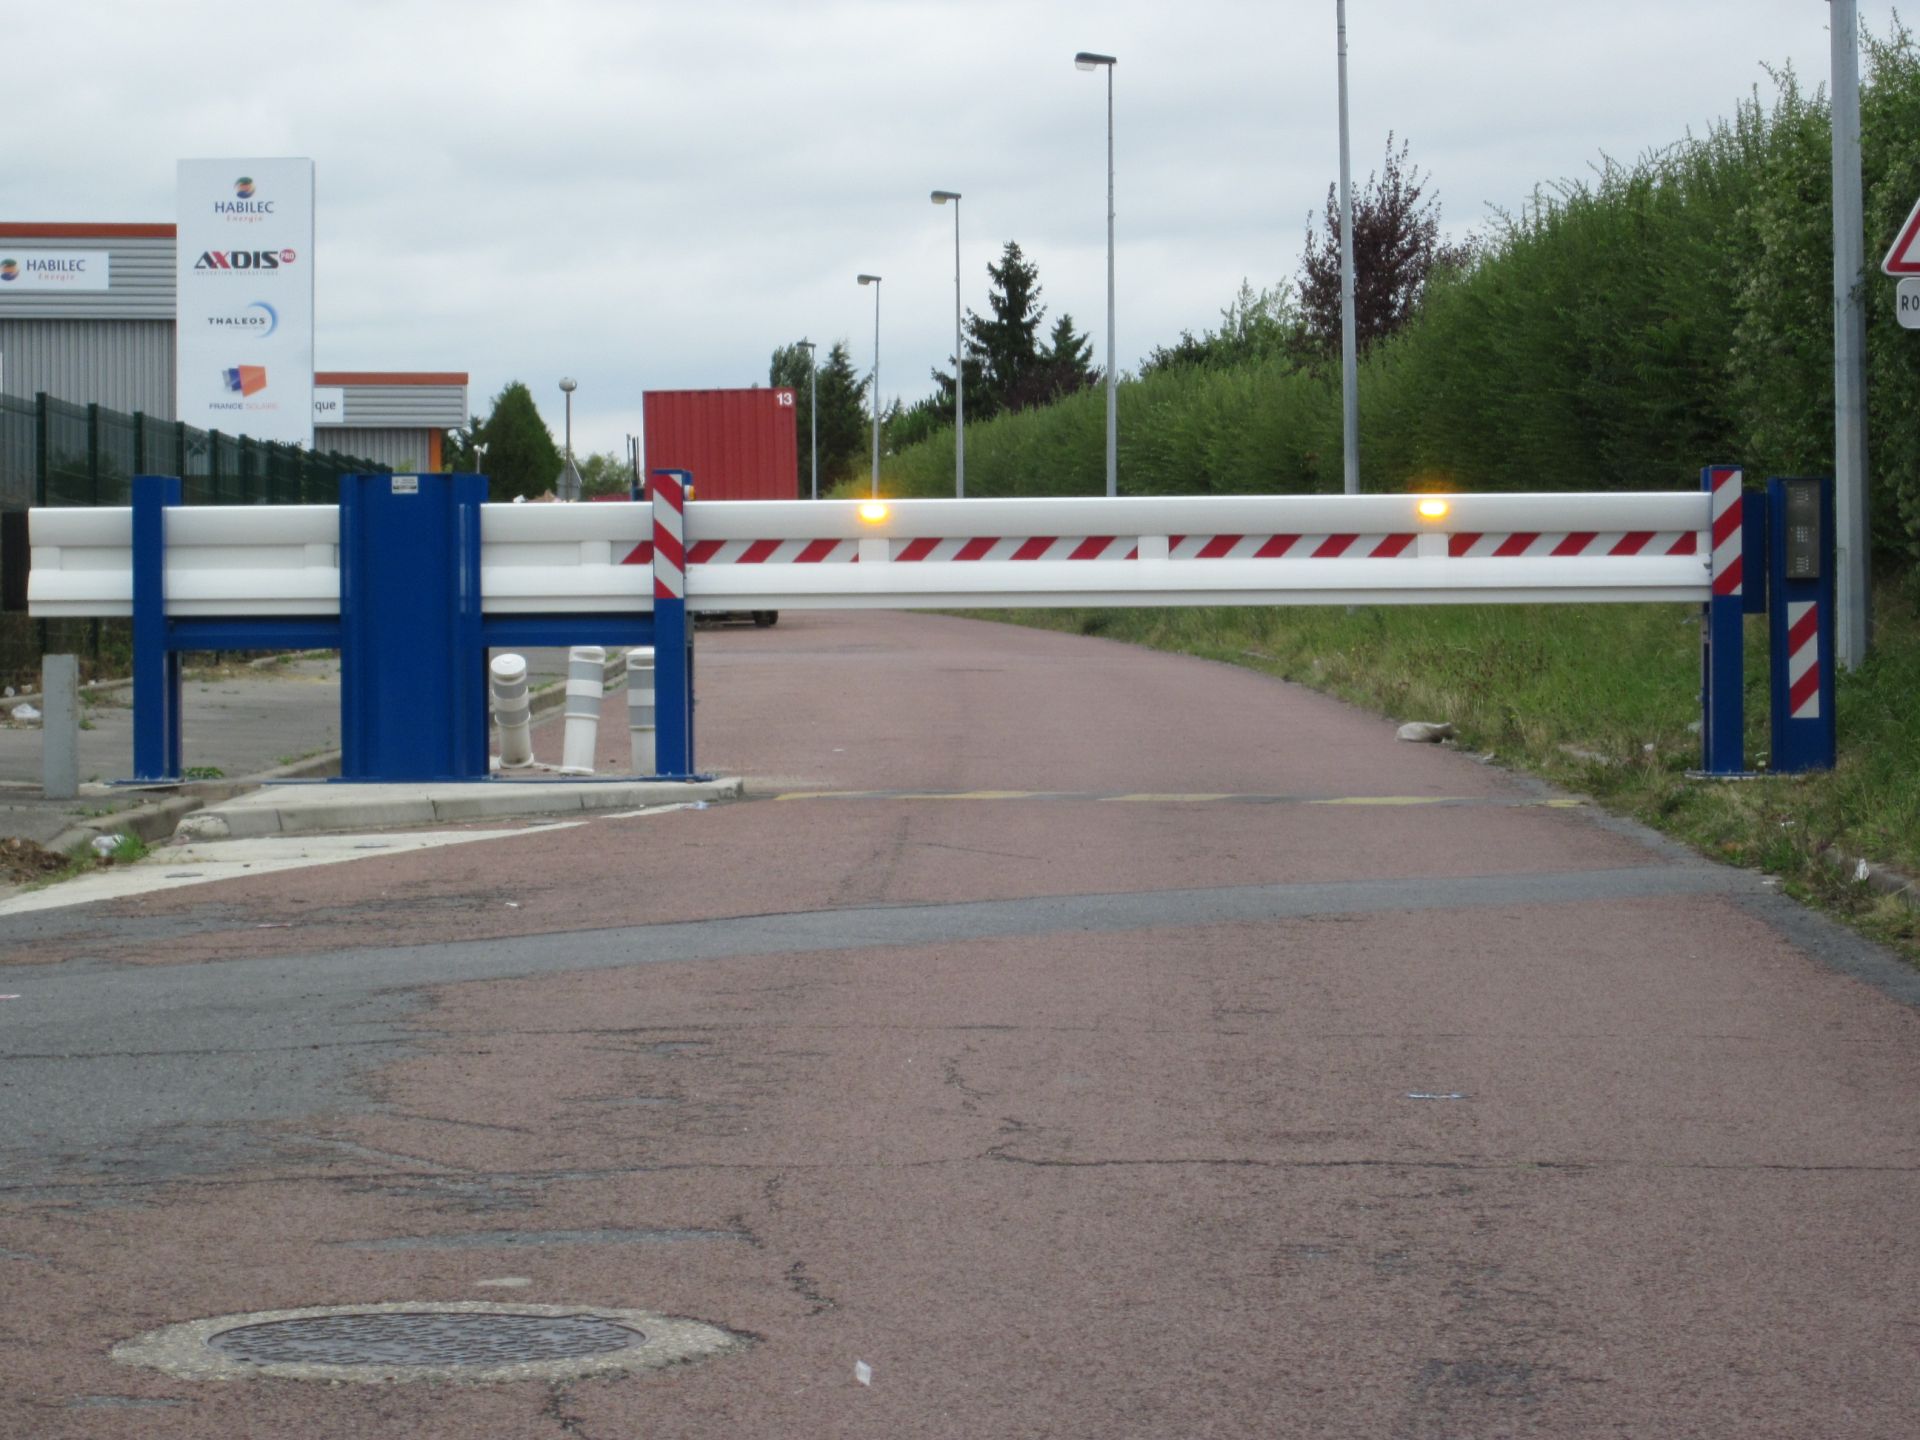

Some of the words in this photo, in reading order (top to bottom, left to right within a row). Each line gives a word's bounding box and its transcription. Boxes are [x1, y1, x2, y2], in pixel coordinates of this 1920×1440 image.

[214, 201, 274, 213] HABILEC
[26, 259, 86, 271] HABILEC
[194, 251, 279, 269] AXDIS
[208, 317, 267, 325] THALEOS
[776, 392, 792, 406] 13
[209, 402, 243, 410] FRANCE
